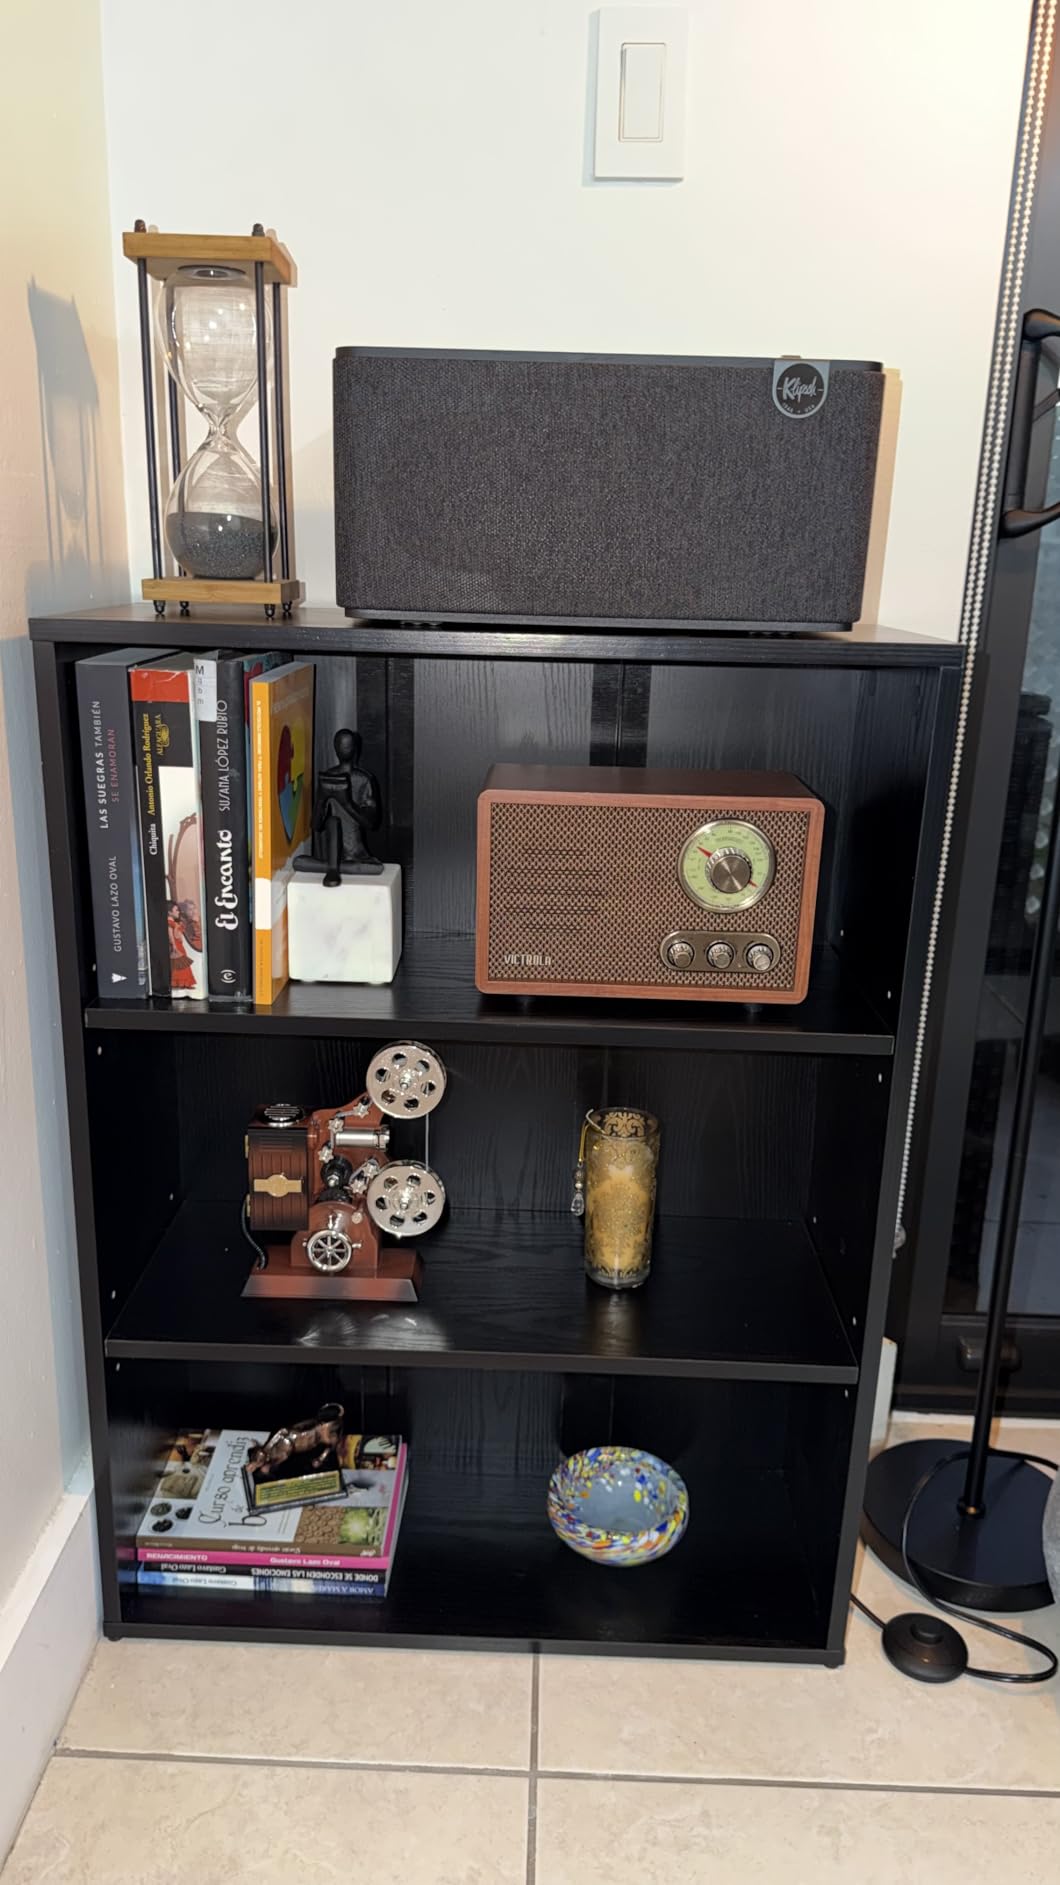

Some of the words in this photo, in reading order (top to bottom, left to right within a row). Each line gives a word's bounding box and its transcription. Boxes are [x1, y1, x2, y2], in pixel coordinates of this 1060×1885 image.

[91, 701, 103, 747] TAMBIÉN
[216, 700, 228, 734] RUBIO
[142, 713, 152, 751] Rodríguez
[107, 729, 118, 787] ENAMORAN
[215, 738, 229, 771] LÓPEZ
[96, 752, 107, 804] SUEGRAS
[144, 752, 153, 784] Orlando
[111, 791, 119, 802] SE
[146, 785, 155, 816] Antonio
[218, 775, 230, 811] SUSANA
[99, 808, 109, 829] LAS
[148, 824, 159, 855] Chiquita
[108, 856, 118, 880] OVAL
[215, 829, 239, 910] Encanto
[110, 882, 119, 908] LAZO
[111, 909, 122, 952] GUSTAVO
[215, 912, 239, 931] El
[504, 954, 551, 966] VICTROLA
[198, 1486, 231, 1528] Curso
[146, 1552, 208, 1561] RENACIMIENTO
[160, 1562, 178, 1571] Oval
[179, 1564, 196, 1572] Lazo
[269, 1556, 302, 1564] Gustavo
[323, 1558, 340, 1566] Oval
[197, 1565, 226, 1574] Gustavo
[251, 1567, 291, 1577] EMOCIONES
[292, 1570, 305, 1578] LAS
[306, 1571, 342, 1580] ESCONDEN
[355, 1574, 379, 1582] DONDE
